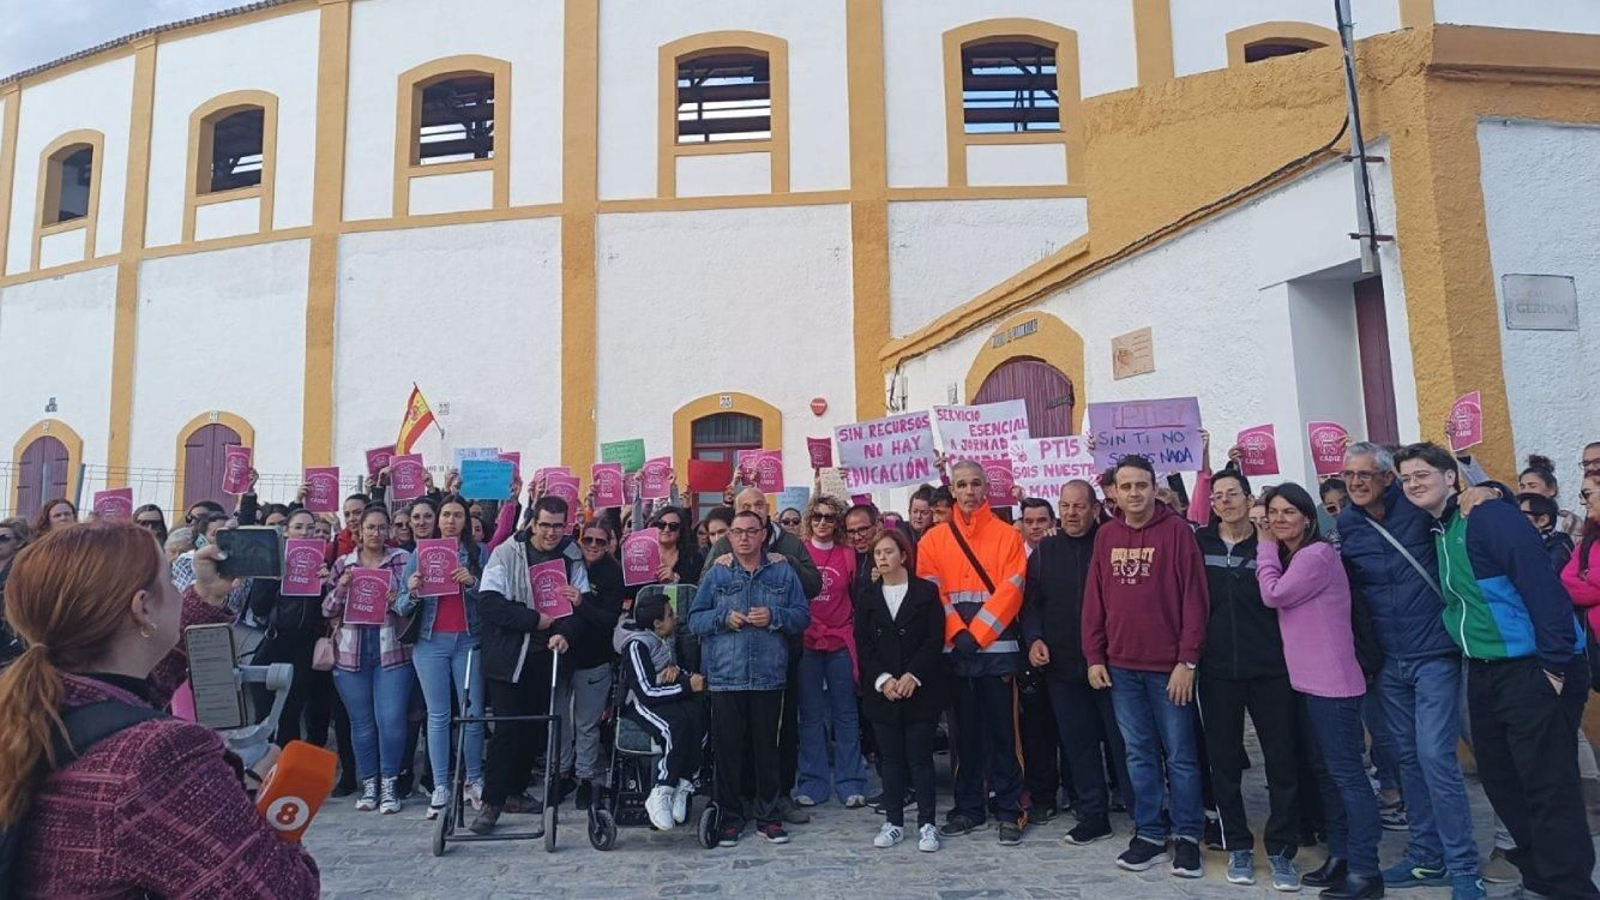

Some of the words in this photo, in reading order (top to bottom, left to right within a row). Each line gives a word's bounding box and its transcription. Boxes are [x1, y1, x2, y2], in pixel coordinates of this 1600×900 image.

[1516, 303, 1569, 315] GERONA
[937, 408, 980, 421] SERVICIO
[839, 426, 863, 442] SIN
[868, 415, 930, 438] RECURSOS
[969, 417, 1029, 437] ESENCIAL
[864, 442, 884, 459] NO
[891, 435, 921, 456] HAY
[951, 438, 957, 451] A
[1098, 431, 1126, 446] SIN
[1132, 431, 1150, 444] TI
[1161, 430, 1185, 444] NO
[1039, 438, 1080, 460] PTIS
[1159, 447, 1194, 463] NADA
[847, 456, 930, 488] EDUCACIÓN
[1012, 465, 1038, 479] SOIS
[276, 802, 299, 825] 8
